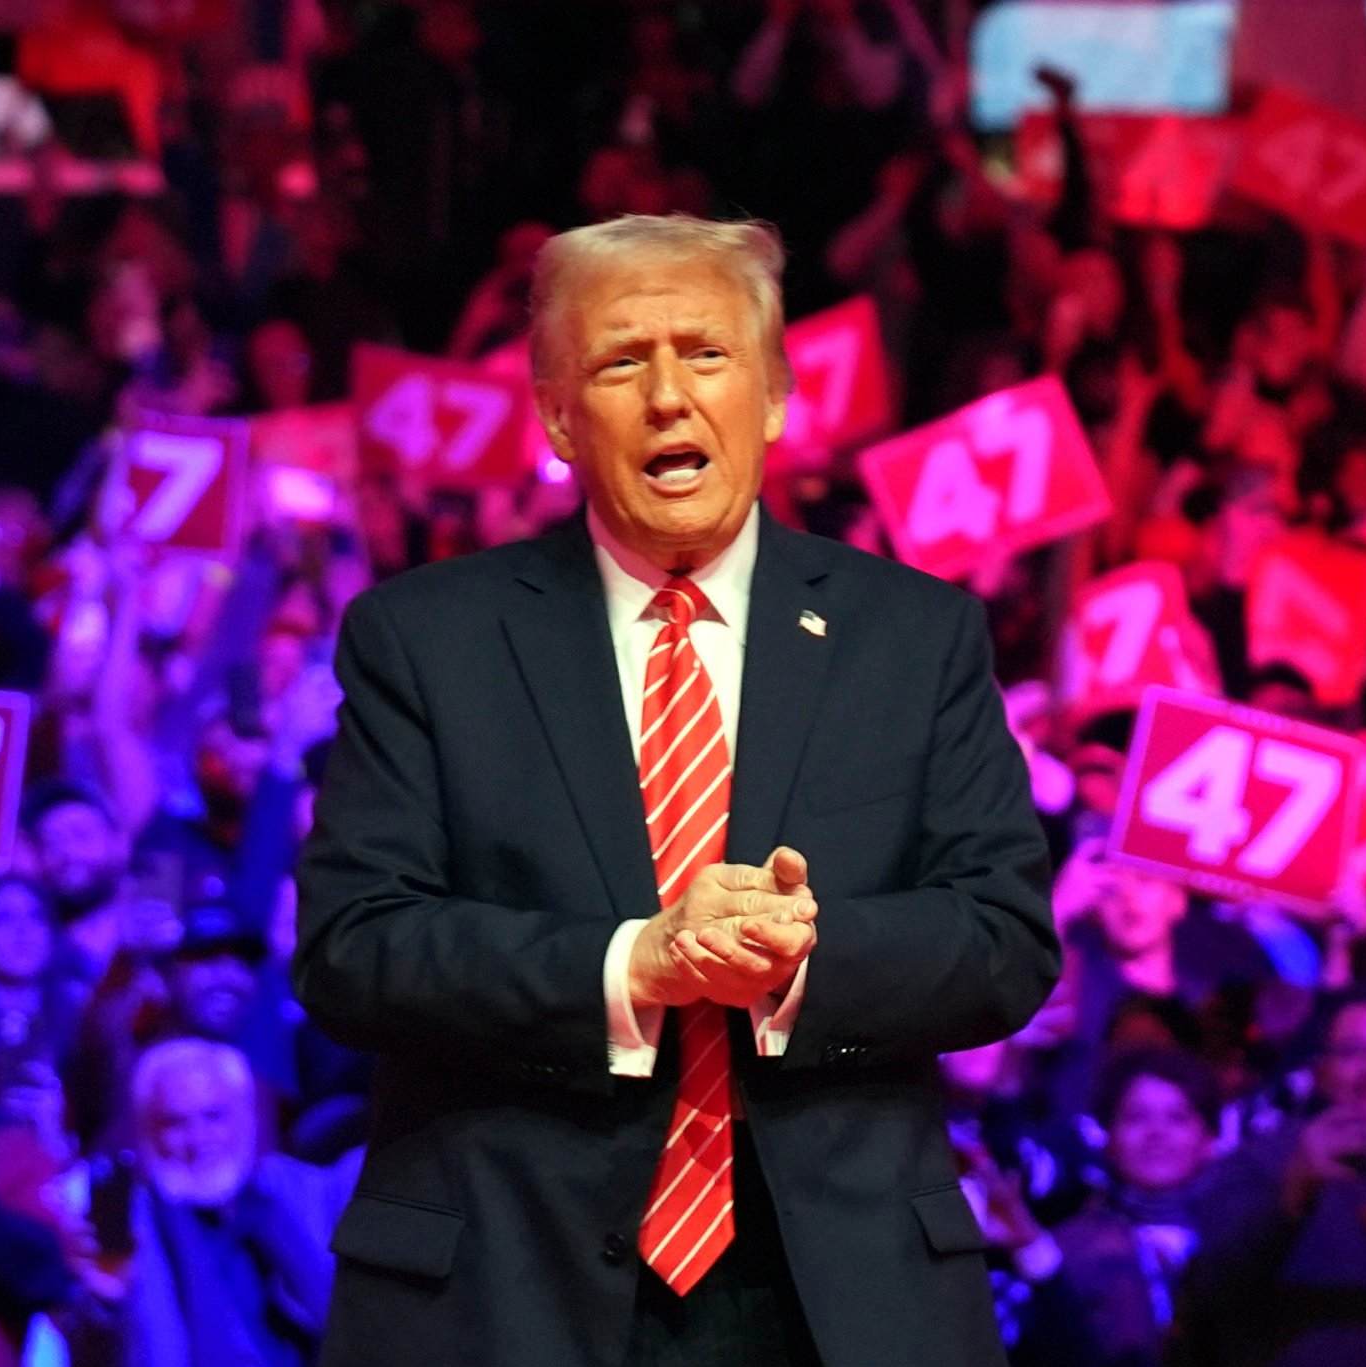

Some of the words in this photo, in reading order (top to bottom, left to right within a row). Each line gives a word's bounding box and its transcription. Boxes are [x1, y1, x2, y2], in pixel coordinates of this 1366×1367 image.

[364, 372, 512, 472] 47
[785, 328, 863, 438] 7
[906, 398, 1053, 545] 47
[1140, 724, 1342, 877] 47
